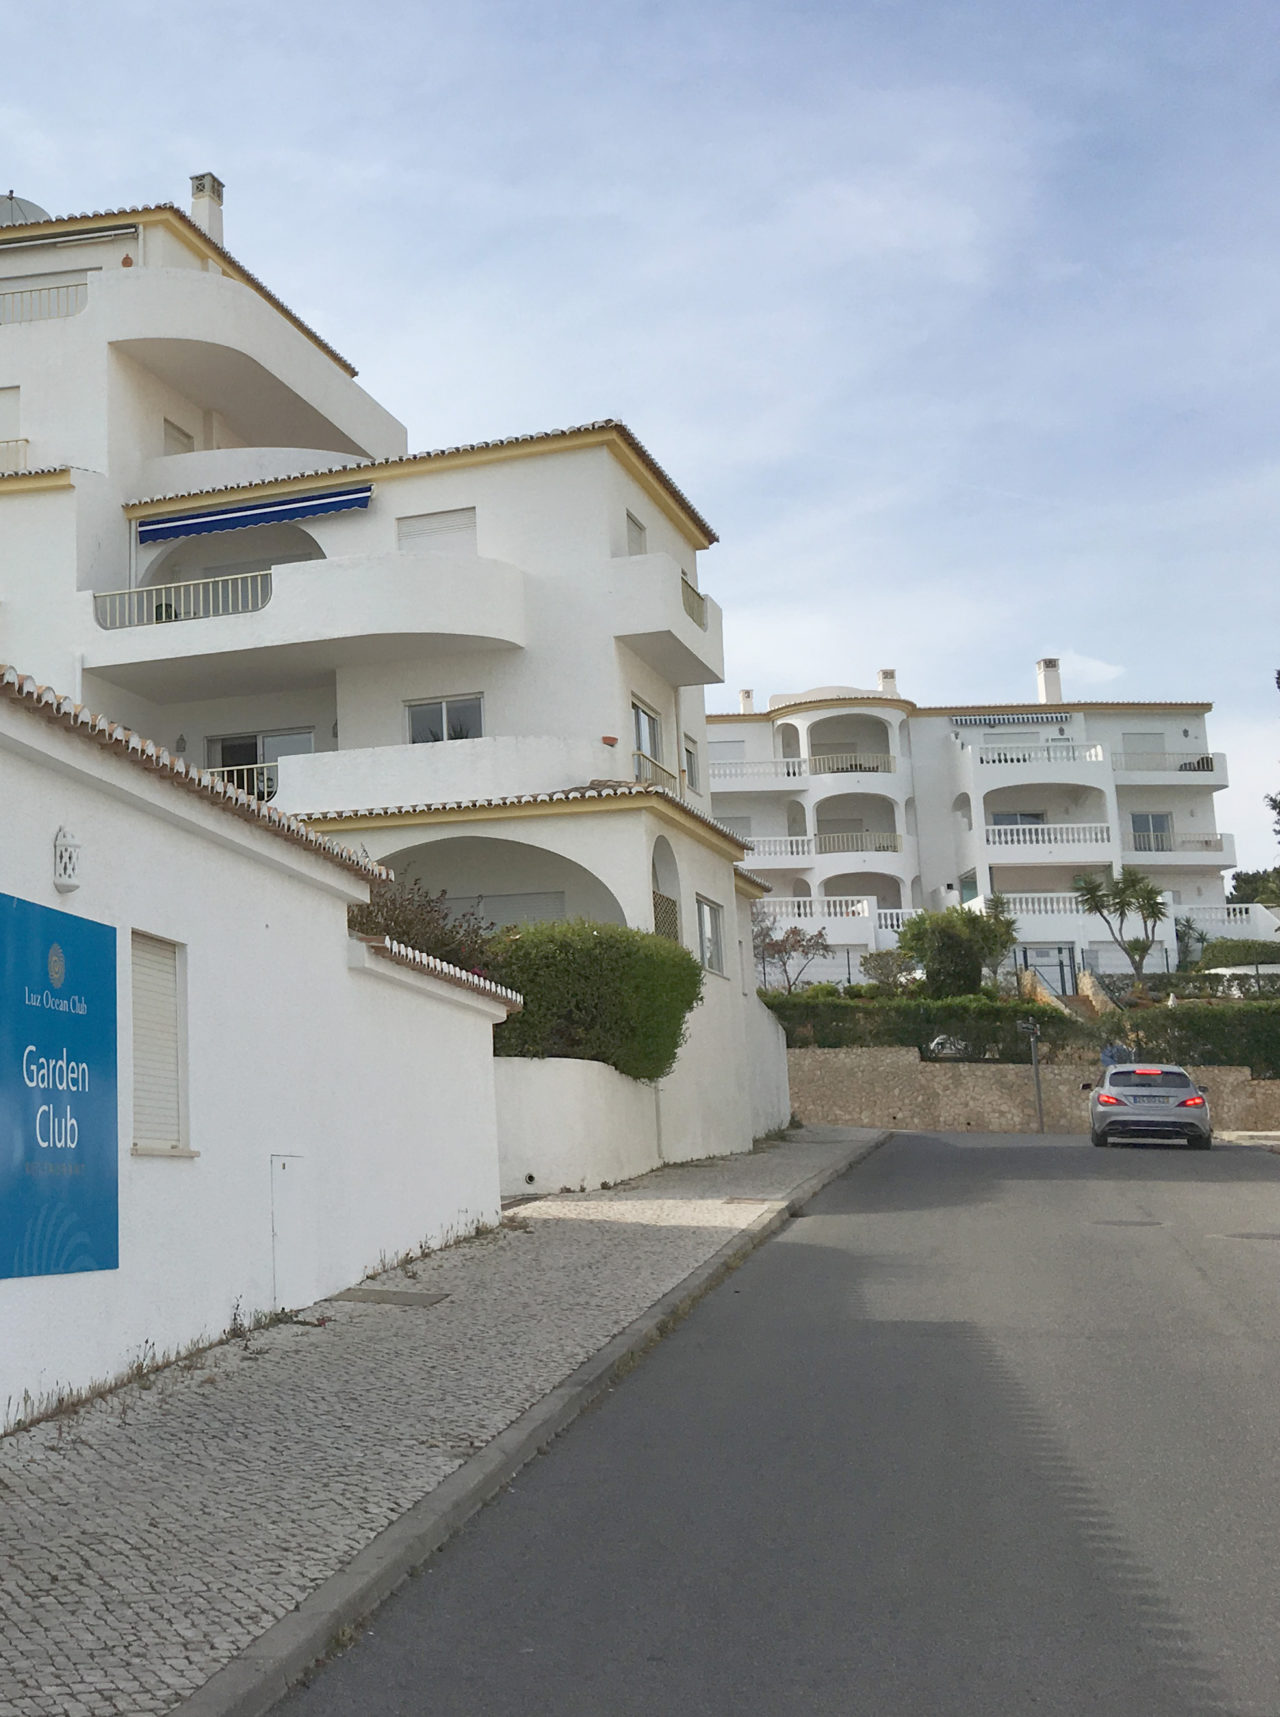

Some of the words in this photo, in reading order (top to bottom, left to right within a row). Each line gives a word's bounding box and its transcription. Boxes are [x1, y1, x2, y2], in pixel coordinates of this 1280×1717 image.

[25, 986, 41, 1007] Luz
[43, 990, 69, 1012] Ocean
[70, 995, 87, 1015] Club
[23, 1045, 89, 1093] Garden
[35, 1105, 78, 1149] Club
